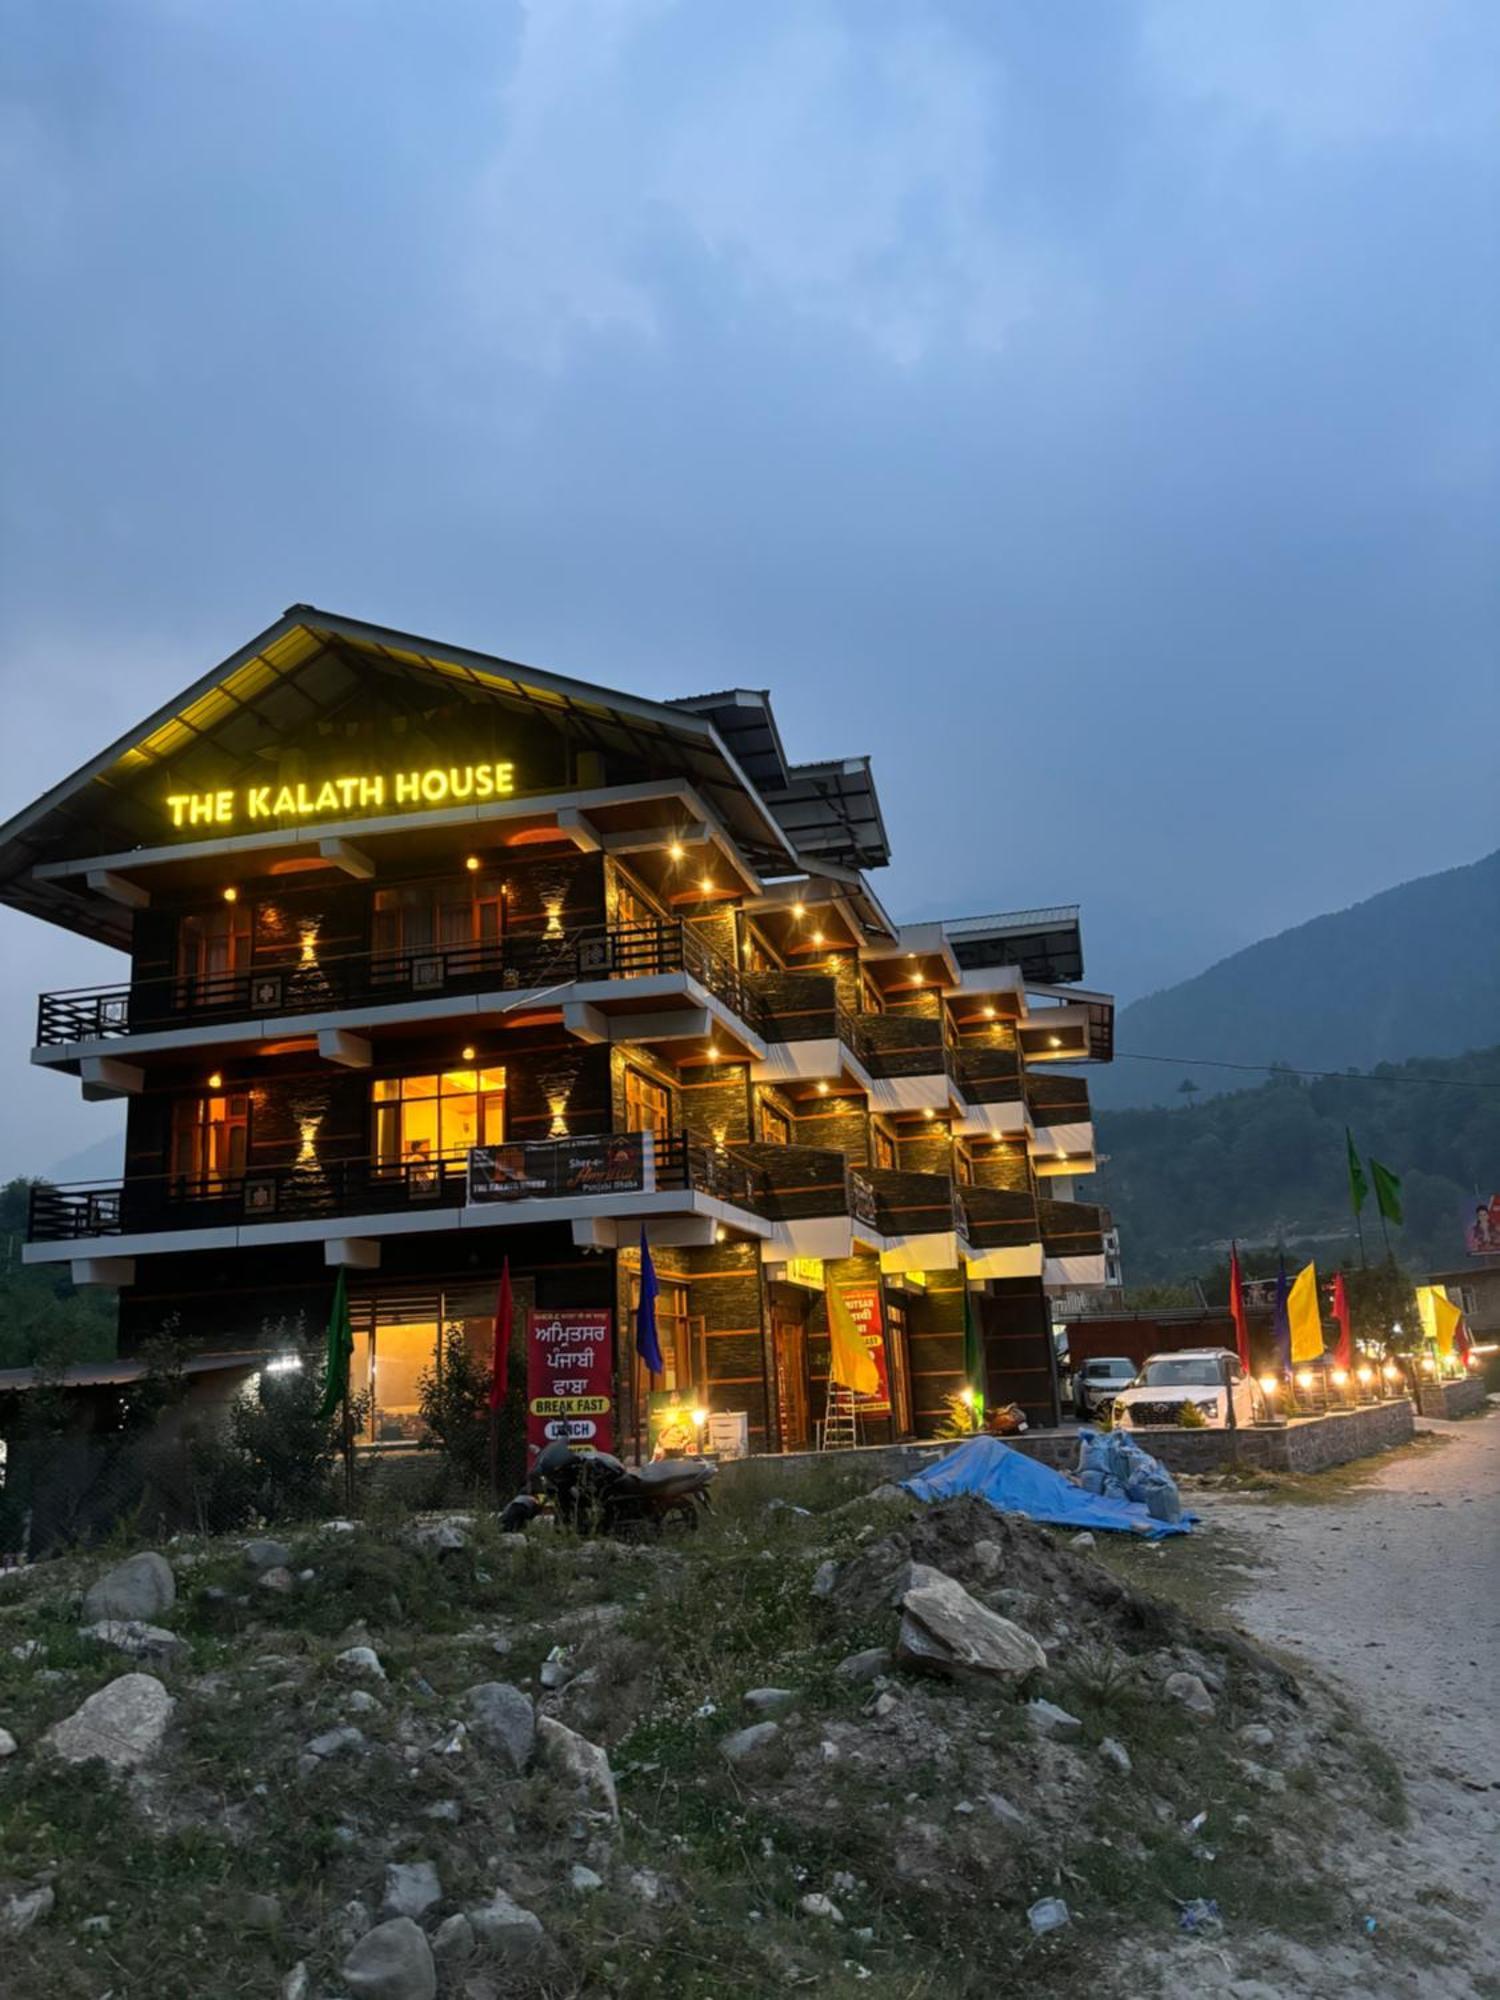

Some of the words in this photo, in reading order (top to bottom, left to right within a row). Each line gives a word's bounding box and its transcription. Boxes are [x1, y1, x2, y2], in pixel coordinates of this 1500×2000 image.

[166, 790, 234, 826] THE
[248, 776, 383, 819] KALATH
[396, 763, 514, 803] HOUSE
[536, 1401, 574, 1413] BREAK
[577, 1399, 604, 1411] FAST
